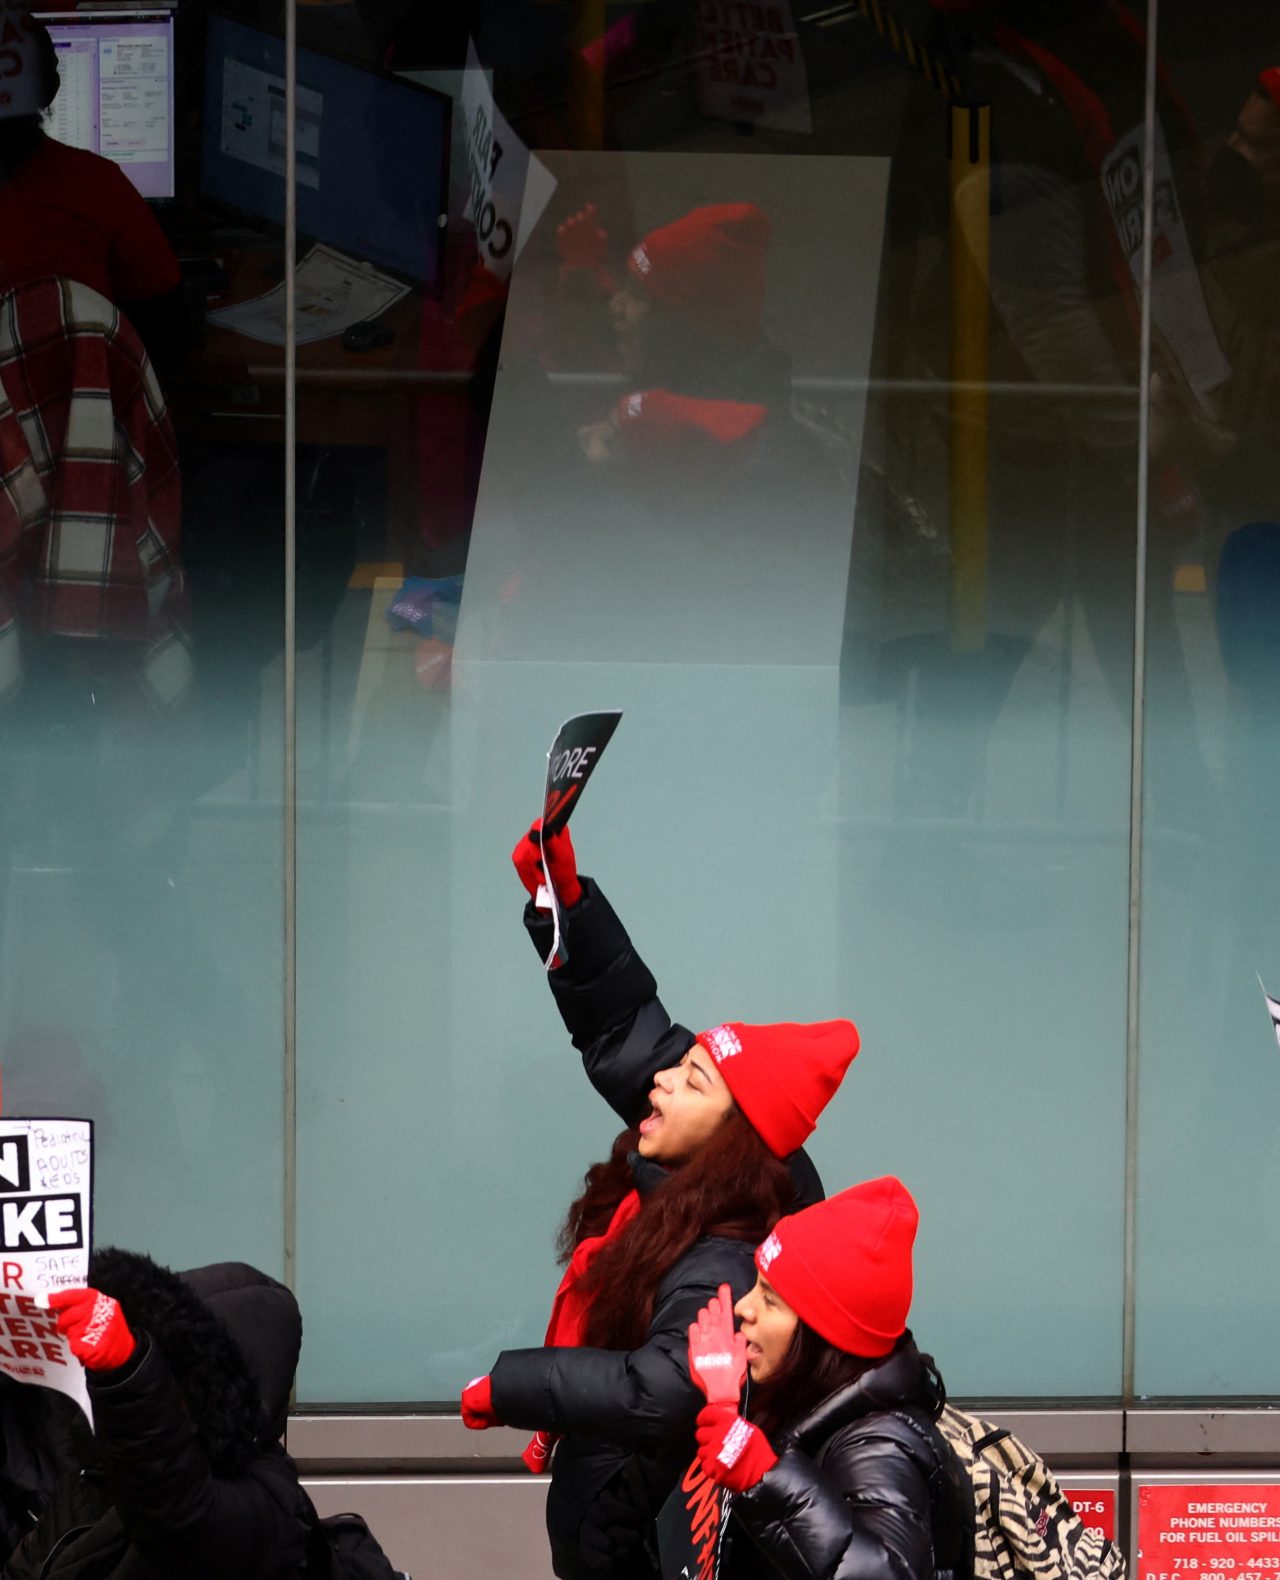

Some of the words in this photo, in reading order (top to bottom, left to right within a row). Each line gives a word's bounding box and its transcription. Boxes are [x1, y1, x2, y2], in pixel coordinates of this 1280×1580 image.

[1073, 1502, 1105, 1513] DT-6
[1187, 1503, 1268, 1514] EMERGENCY
[1170, 1517, 1216, 1528] PHONE
[1219, 1517, 1280, 1528] NUMBERS
[1160, 1532, 1185, 1543] FOR
[1189, 1532, 1222, 1542] FUEL
[1225, 1532, 1248, 1542] OIL
[1250, 1532, 1280, 1542] SPIL
[1173, 1558, 1198, 1569] 718
[1210, 1558, 1235, 1569] 920
[1246, 1557, 1280, 1568] 4433
